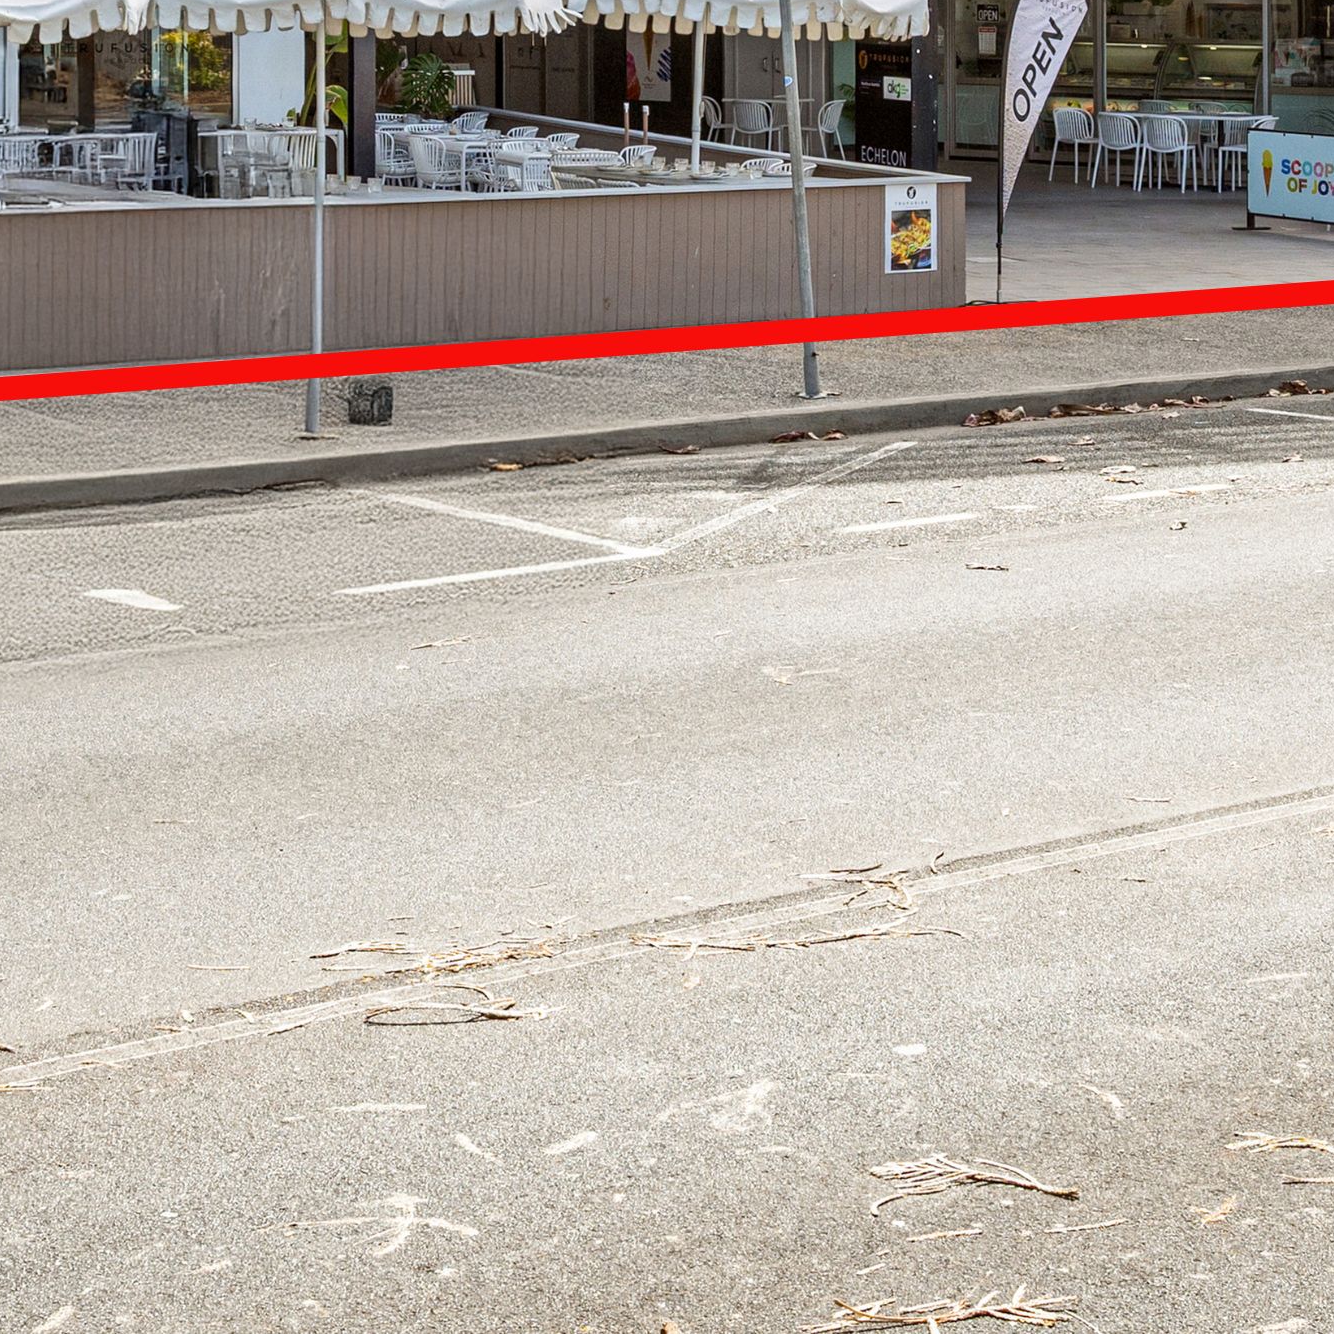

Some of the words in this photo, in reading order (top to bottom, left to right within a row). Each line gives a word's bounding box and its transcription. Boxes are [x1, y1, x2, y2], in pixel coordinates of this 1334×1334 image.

[977, 9, 998, 20] OPEN
[1013, 17, 1064, 122] OPEN
[861, 145, 908, 167] ECHELON
[1287, 177, 1308, 193] OF
